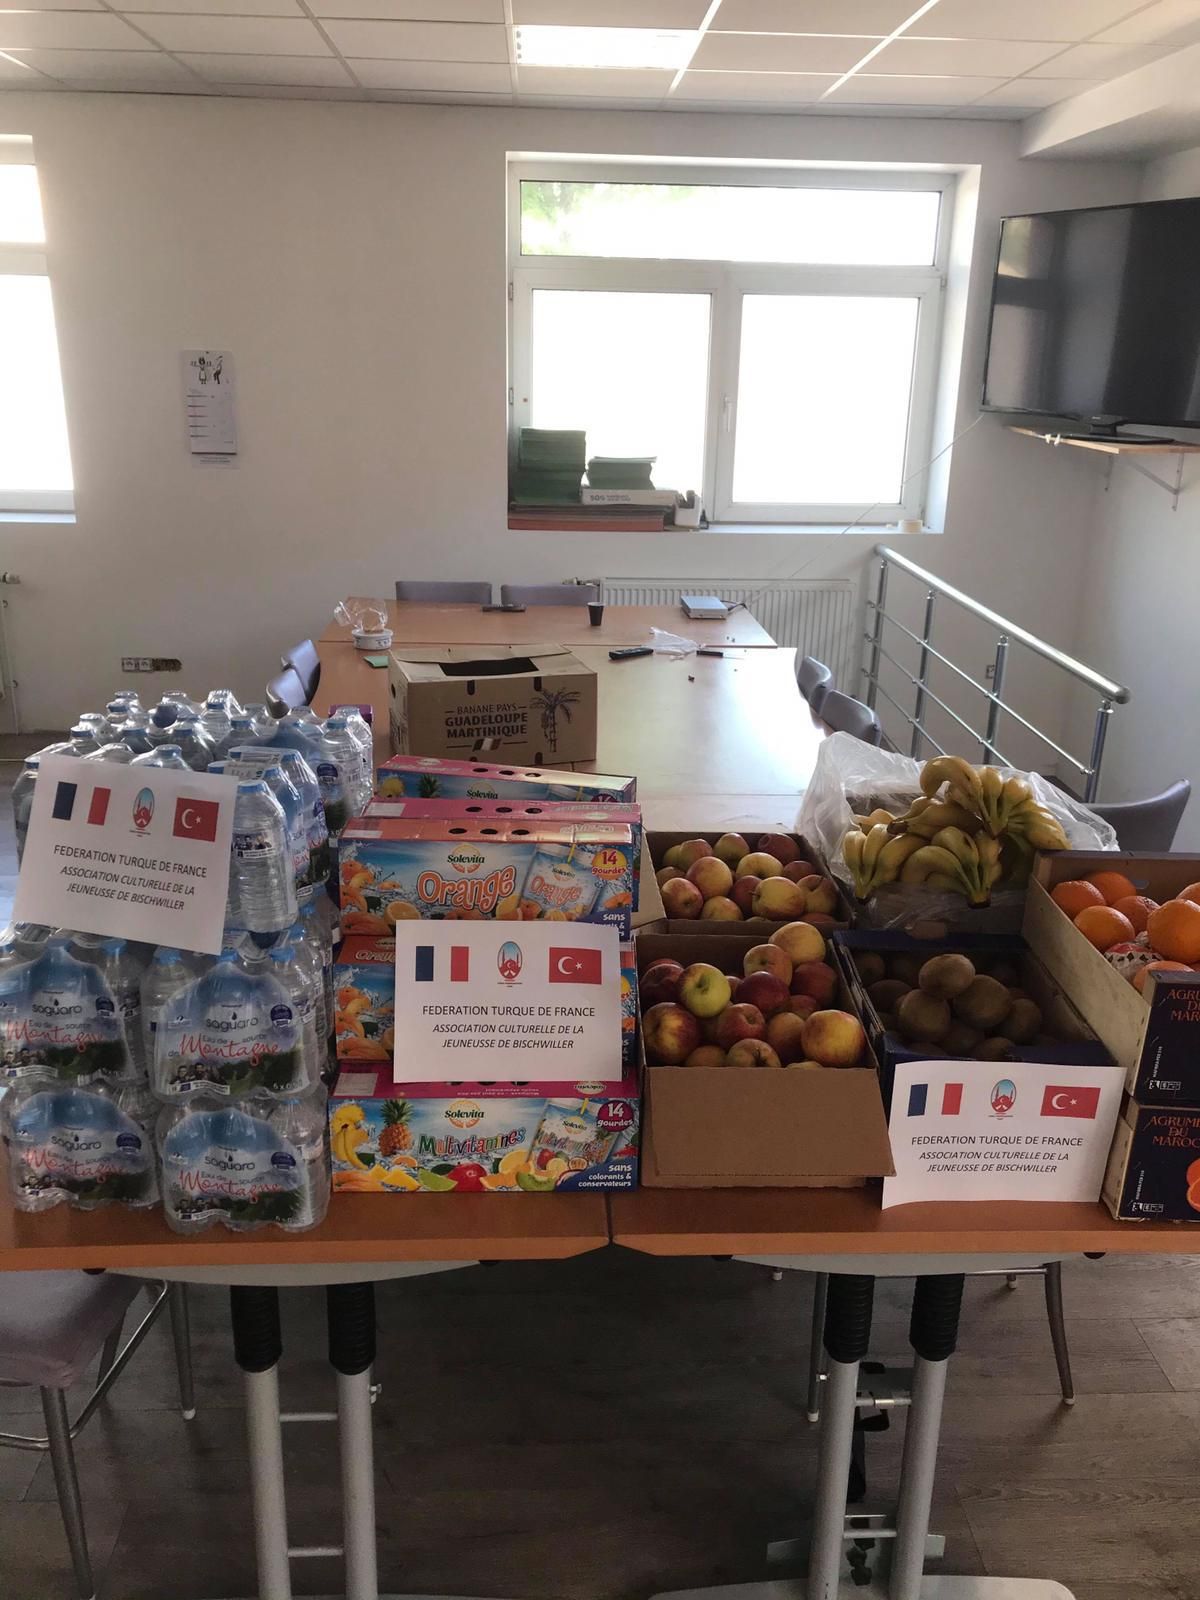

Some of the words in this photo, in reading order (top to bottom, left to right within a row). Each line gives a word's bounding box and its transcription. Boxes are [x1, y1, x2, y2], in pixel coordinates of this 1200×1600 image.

[457, 704, 494, 714] BANANE
[496, 702, 517, 712] PAYS
[445, 712, 528, 727] GUADELOUPE
[447, 724, 527, 738] MARTINIQUE
[466, 789, 498, 800] Solevita
[53, 844, 116, 864] FEDERATION
[118, 854, 158, 870] TURQUE
[158, 860, 171, 872] DE
[172, 863, 208, 878] FRANCE
[447, 855, 485, 864] Solevita
[601, 850, 618, 864] 14
[592, 867, 626, 876] gourdes
[60, 866, 120, 883] ASSOCIATION
[120, 875, 172, 892] CULTURELLE
[172, 883, 184, 894] DE
[184, 886, 195, 896] LA
[417, 864, 517, 913] Orange
[530, 875, 584, 906] Orange
[66, 883, 116, 899] JEUNEUSSE
[116, 891, 130, 901] DE
[130, 893, 185, 910] BISCHWILLER
[602, 913, 626, 921] sans
[32, 1004, 82, 1016] saguaro
[422, 1005, 488, 1016] FEDERATION
[492, 1006, 535, 1017] TURQUE
[538, 1006, 552, 1016] DE
[554, 1006, 595, 1016] FRANCE
[1187, 1000, 1200, 1010] D
[206, 1017, 259, 1032] saguaro
[432, 1024, 496, 1033] ASSOCIATION
[498, 1024, 556, 1034] CULTURELLE
[558, 1025, 571, 1034] DE
[572, 1025, 584, 1034] LA
[180, 1033, 281, 1066] Montagne
[442, 1039, 496, 1048] JEUNEUSSE
[498, 1040, 510, 1048] DE
[512, 1040, 574, 1048] BISCHWILLER
[444, 1110, 485, 1118] Solevita
[608, 1102, 624, 1118] 14
[598, 1119, 633, 1128] gourdes
[1169, 1127, 1189, 1137] DU
[51, 1136, 102, 1151] saguaro
[911, 1136, 976, 1145] FEDERATION
[980, 1136, 1022, 1146] TURQUE
[1025, 1136, 1039, 1145] DE
[1041, 1137, 1084, 1146] FRANCE
[1153, 1136, 1200, 1148] MAROC
[919, 1152, 982, 1160] ASSOCIATION
[983, 1152, 1041, 1160] CULTURELLE
[1042, 1152, 1056, 1160] DE
[204, 1156, 256, 1171] saguaro
[608, 1164, 632, 1172] sans
[927, 1164, 979, 1172] JEUNEUSSE
[981, 1164, 994, 1172] DE
[996, 1164, 1058, 1173] BISCHWILLER
[180, 1170, 281, 1204] Montagne
[578, 1180, 632, 1188] conservateurs
